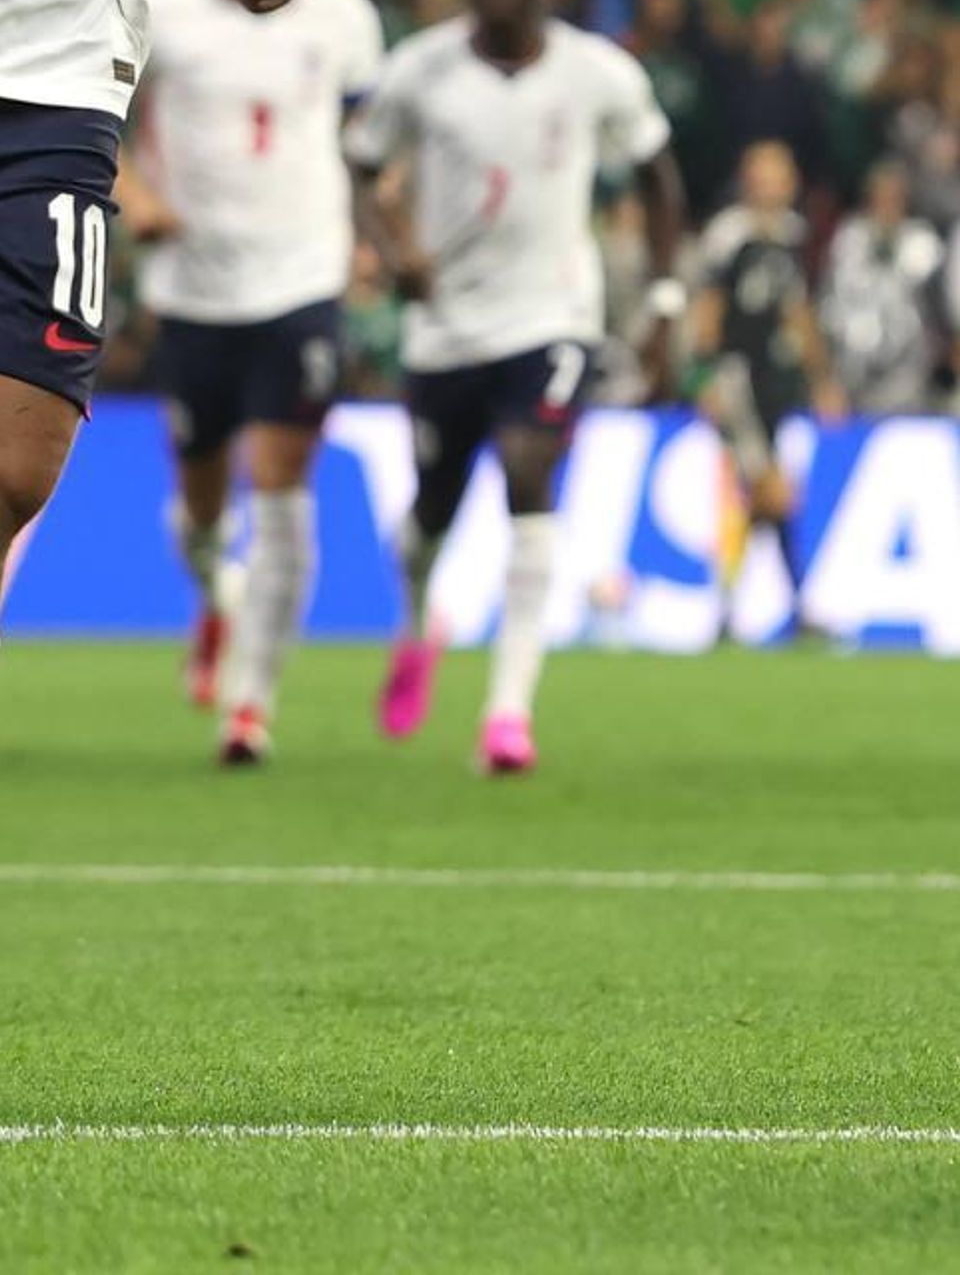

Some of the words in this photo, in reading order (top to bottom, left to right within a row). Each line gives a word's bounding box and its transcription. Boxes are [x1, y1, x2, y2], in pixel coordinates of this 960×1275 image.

[48, 192, 106, 329] 10
[546, 341, 587, 407] 7
[322, 402, 960, 656] VISA
